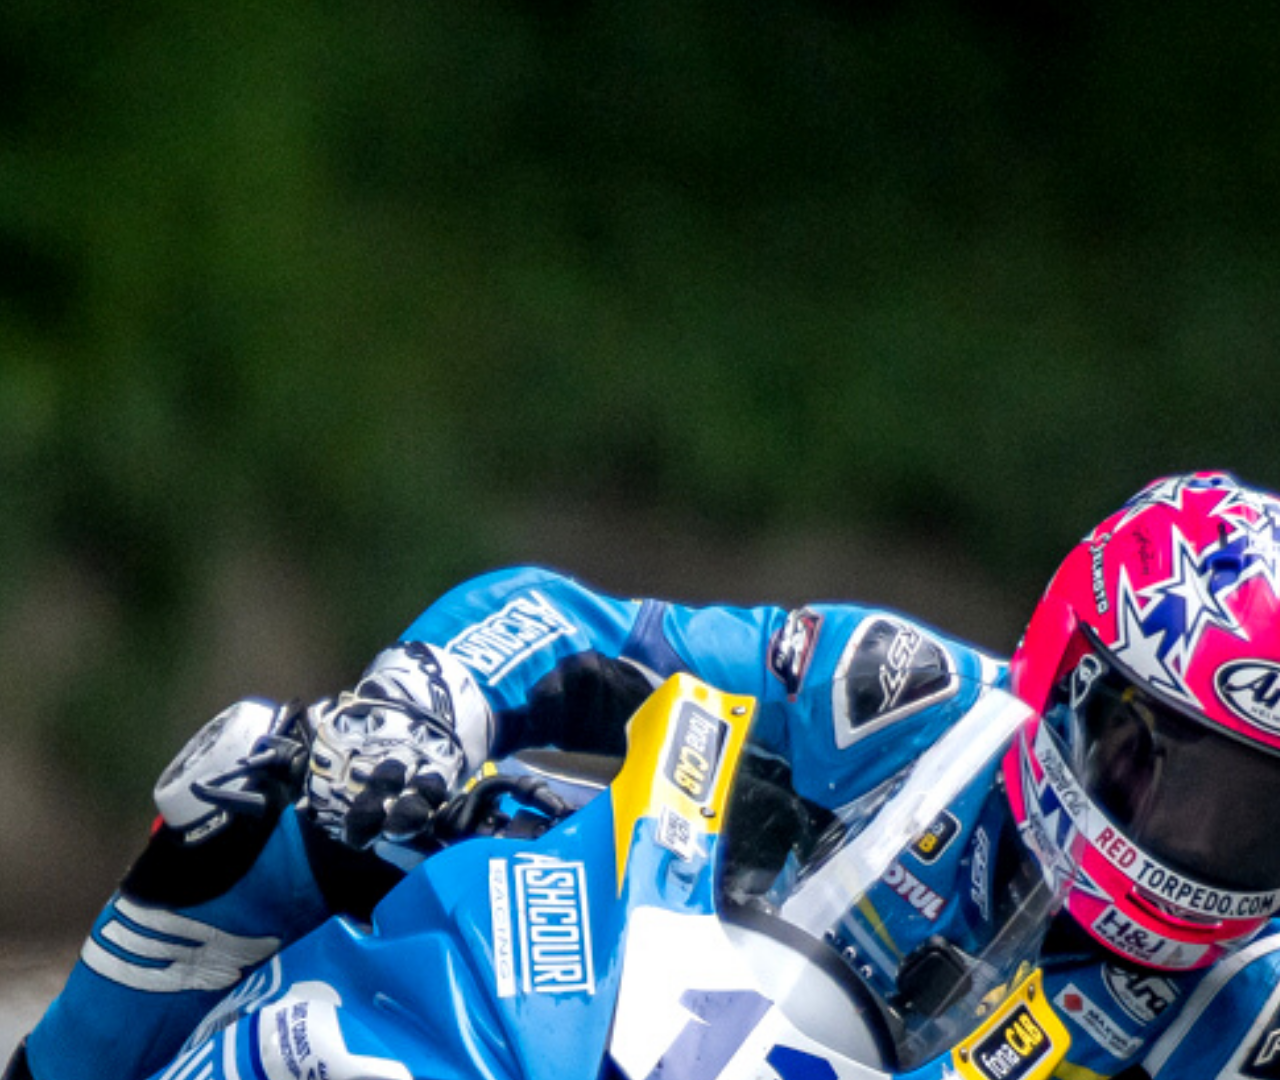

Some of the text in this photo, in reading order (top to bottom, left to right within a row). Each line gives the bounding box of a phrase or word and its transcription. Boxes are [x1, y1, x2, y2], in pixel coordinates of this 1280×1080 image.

[877, 622, 921, 713] RST
[1095, 826, 1138, 870] RED
[1136, 859, 1276, 918] TORPEDO.COM
[513, 851, 597, 995] ASHCOURT
[1098, 908, 1166, 953] H&J
[980, 1012, 1045, 1080] fonaCAB
